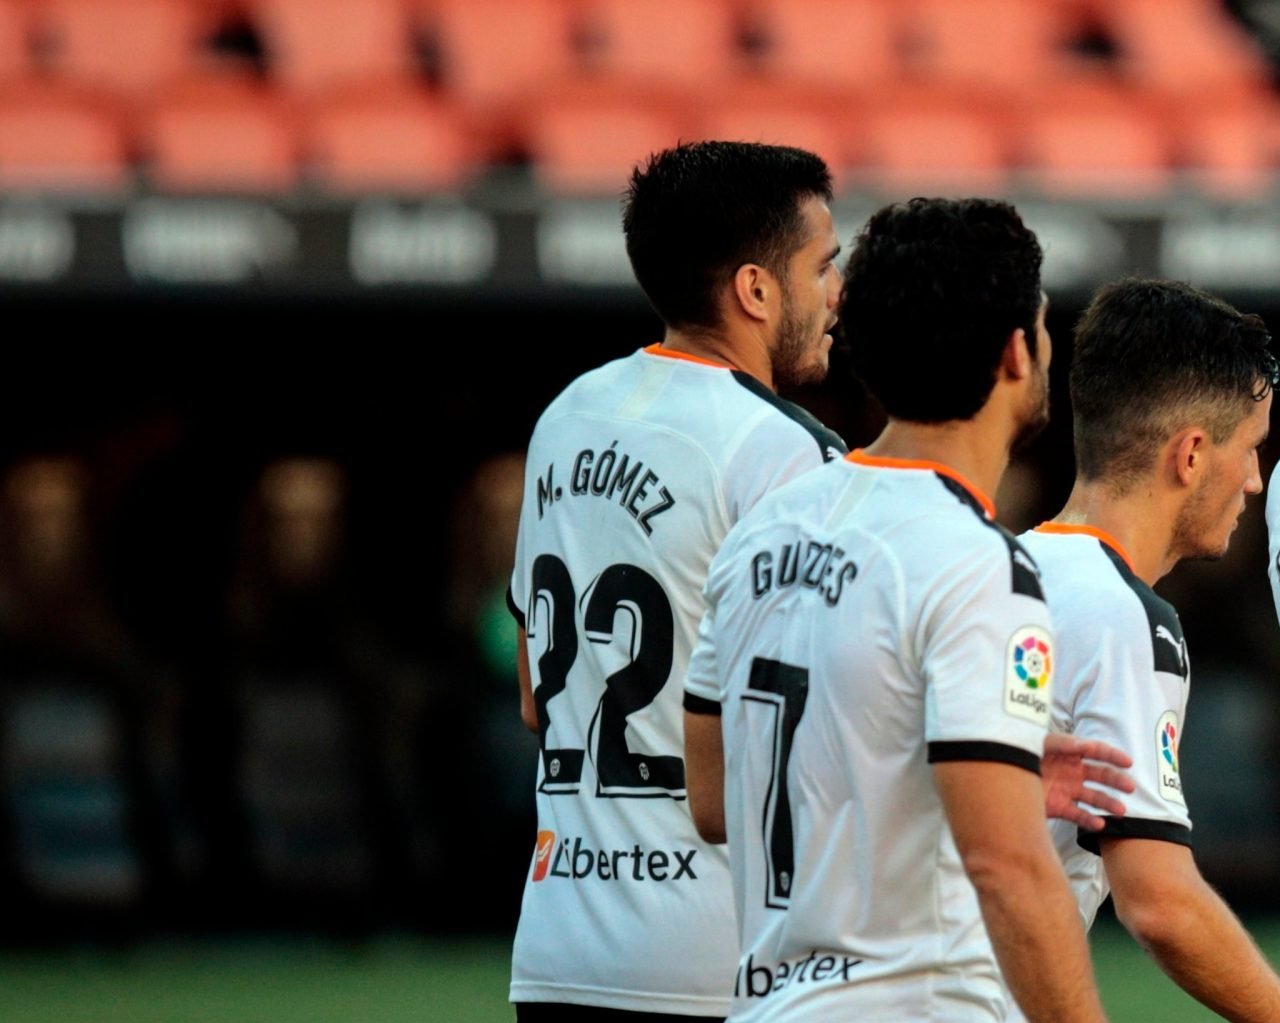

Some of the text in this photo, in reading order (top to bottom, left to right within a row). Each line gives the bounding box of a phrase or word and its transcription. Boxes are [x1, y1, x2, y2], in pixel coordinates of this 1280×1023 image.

[537, 440, 676, 538] M. GÓMEZ
[527, 554, 687, 801] 22
[550, 837, 698, 882] Libertex
[740, 656, 809, 910] 7
